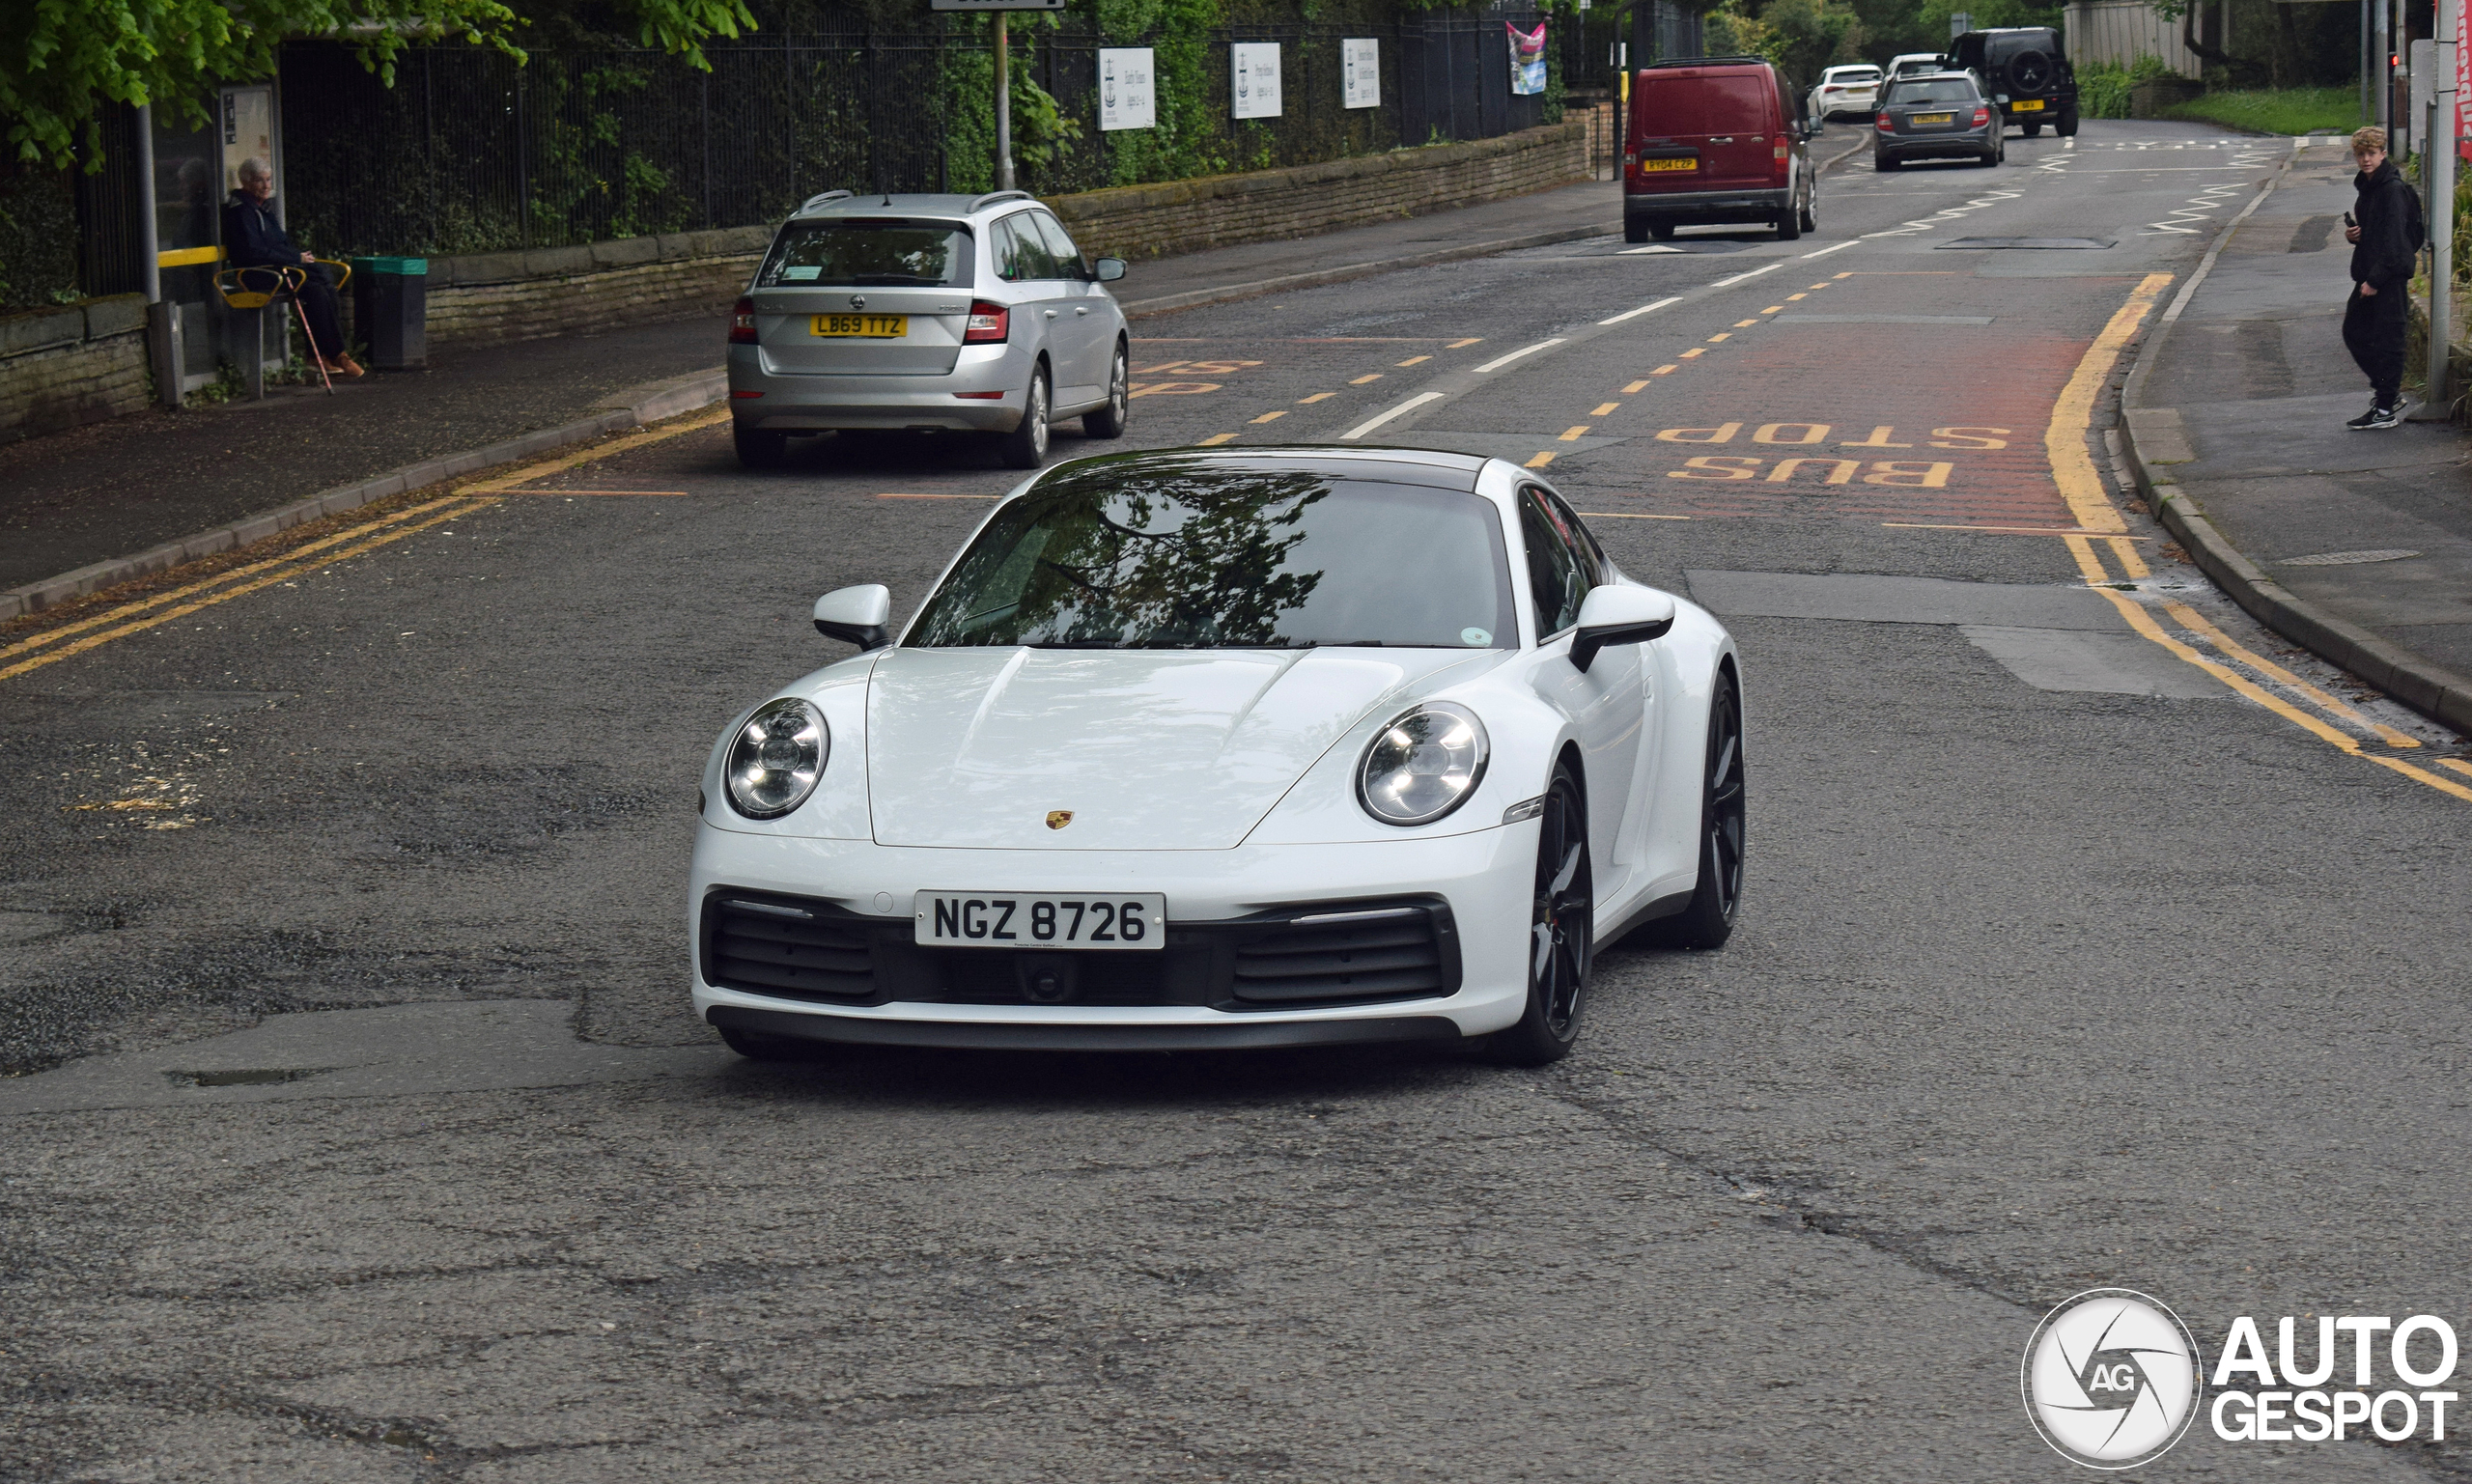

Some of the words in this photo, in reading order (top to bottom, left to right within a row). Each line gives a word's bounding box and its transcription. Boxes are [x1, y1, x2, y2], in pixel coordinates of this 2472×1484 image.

[1649, 160, 1672, 169] RY04
[818, 317, 862, 332] LB69
[867, 317, 901, 333] TTZ
[1654, 422, 2011, 450] STOP
[1667, 456, 1954, 488] BUS
[935, 898, 1017, 939] NGZ
[1031, 900, 1145, 941] 8726
